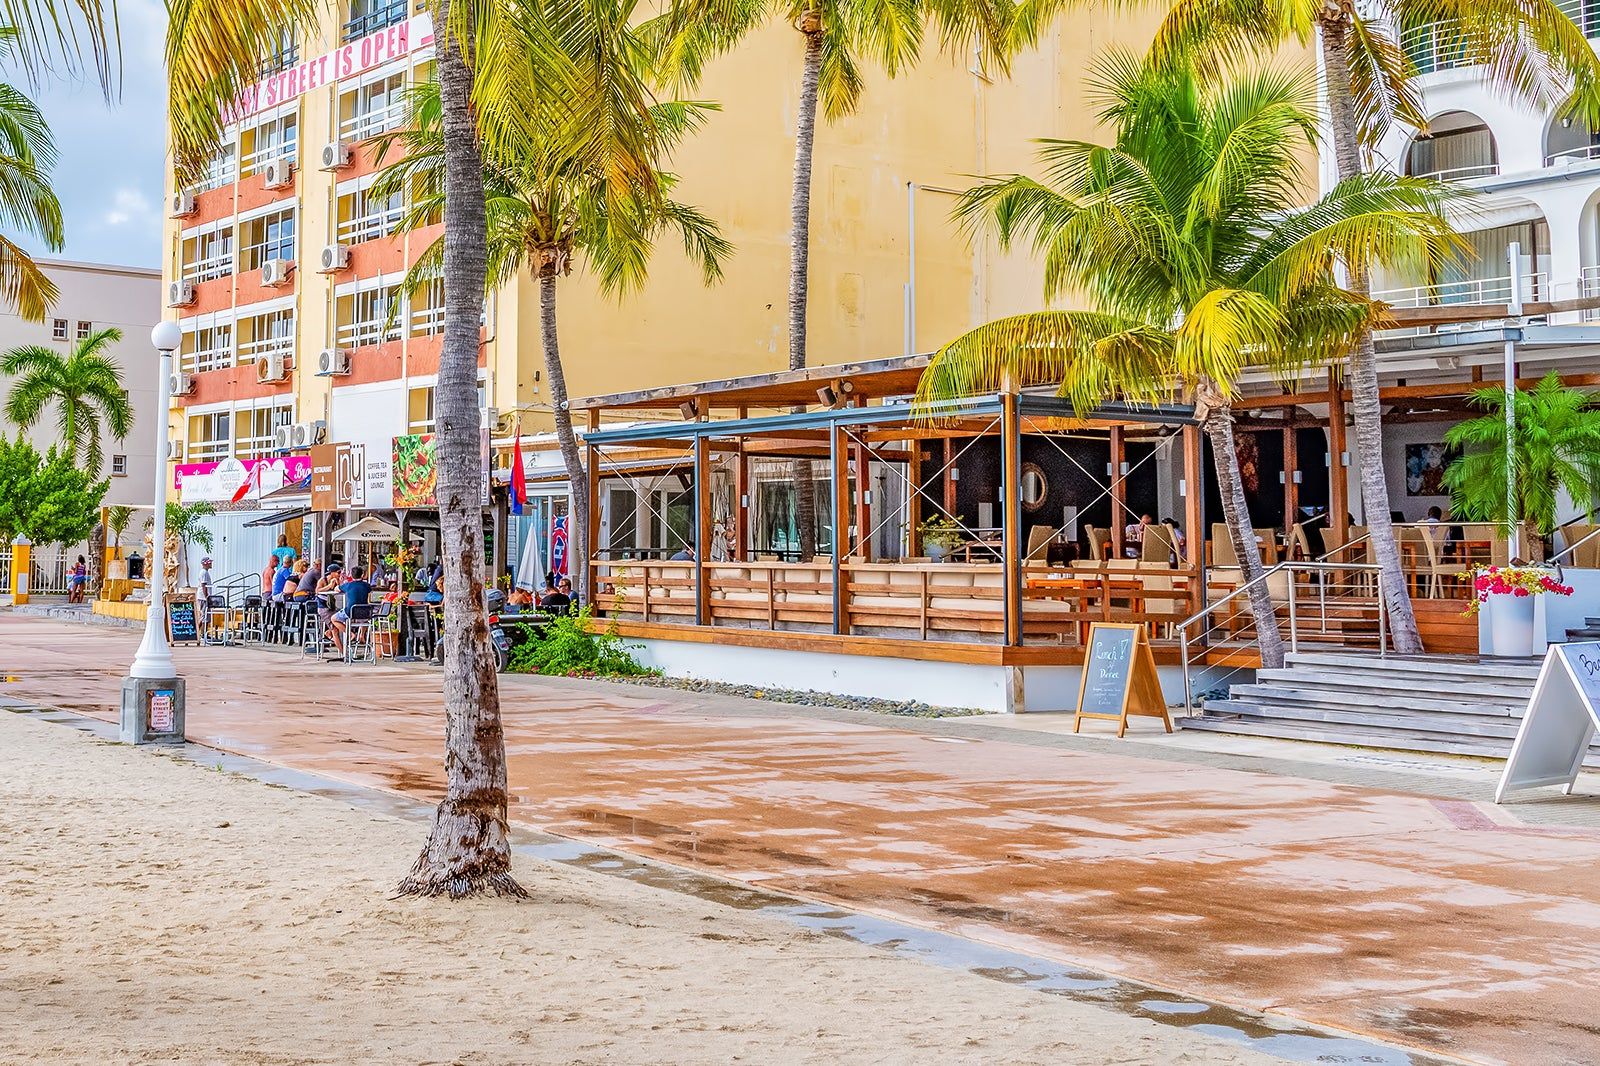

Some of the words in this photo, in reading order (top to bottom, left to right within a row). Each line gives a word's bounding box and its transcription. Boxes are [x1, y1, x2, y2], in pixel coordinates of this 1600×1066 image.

[267, 55, 328, 106] STREET
[334, 46, 353, 79] IS
[361, 21, 410, 69] OPEN
